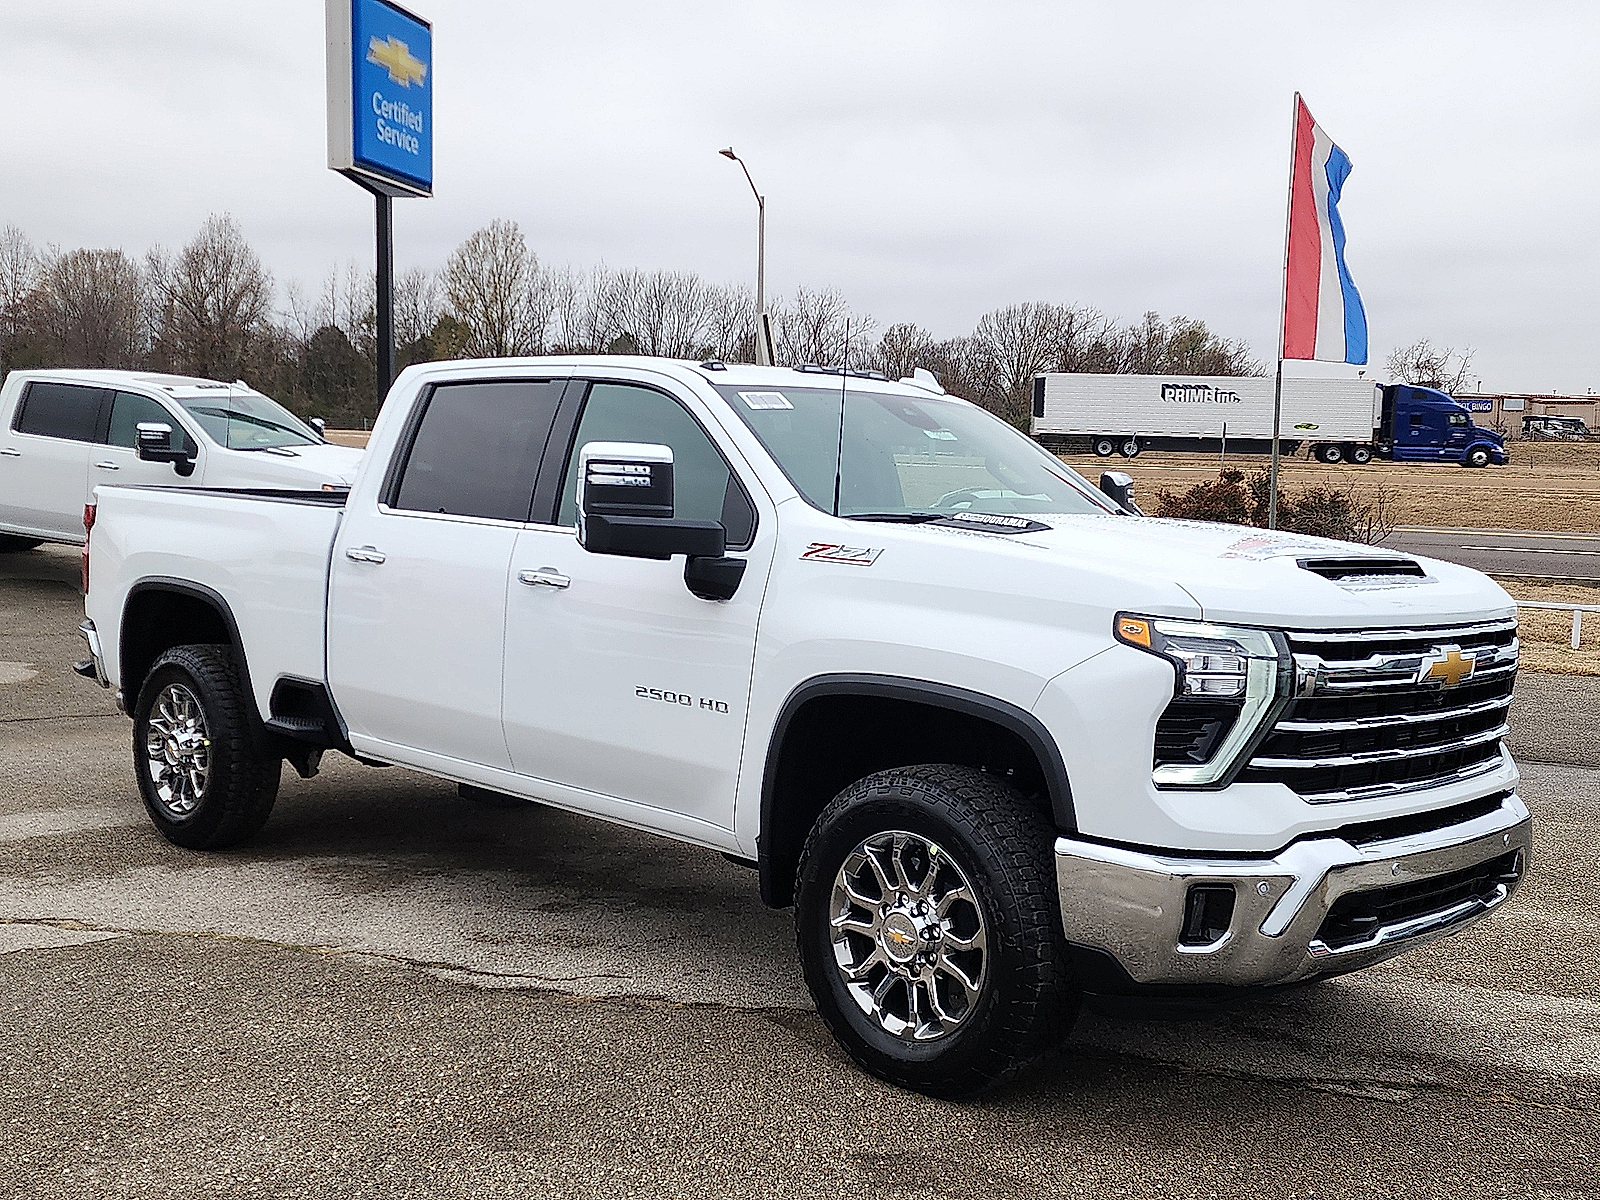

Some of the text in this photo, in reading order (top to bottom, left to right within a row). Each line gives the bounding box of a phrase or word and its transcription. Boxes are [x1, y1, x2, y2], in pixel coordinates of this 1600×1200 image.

[372, 92, 423, 134] Certified
[376, 119, 420, 155] Service
[1161, 384, 1213, 402] PRIME
[1472, 402, 1492, 411] BINGO
[635, 685, 729, 714] 2500 HD
